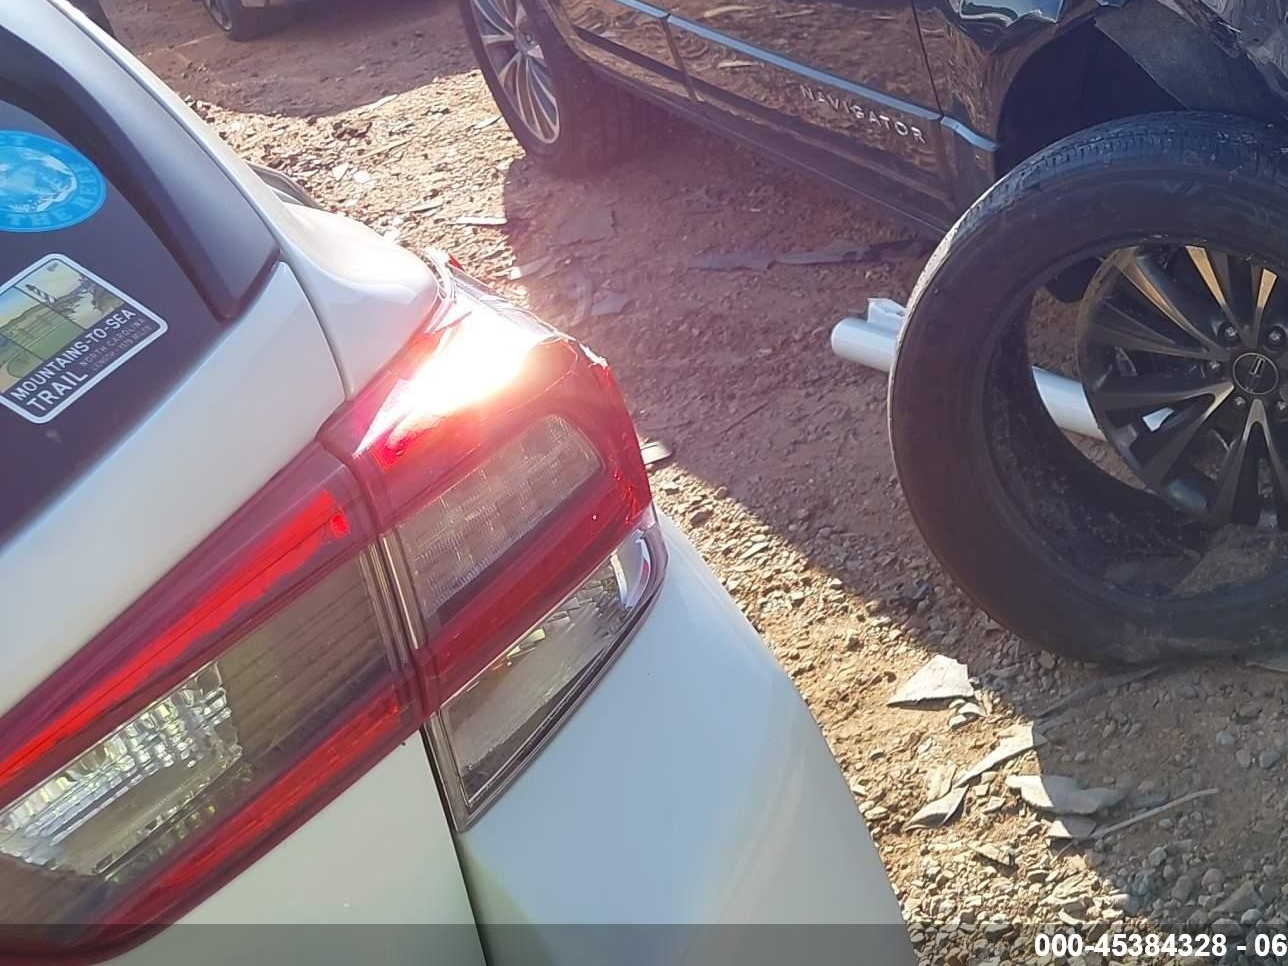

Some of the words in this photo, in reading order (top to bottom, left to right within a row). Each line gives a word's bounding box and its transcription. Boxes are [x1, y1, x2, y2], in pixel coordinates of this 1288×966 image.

[799, 84, 927, 145] NAVIGATOR
[7, 207, 73, 226] THE
[10, 309, 137, 401] MOUNTAINS-TO-SEA
[79, 345, 108, 367] NORTH
[107, 317, 146, 347] CAROLINA
[26, 371, 89, 411] TRAIL
